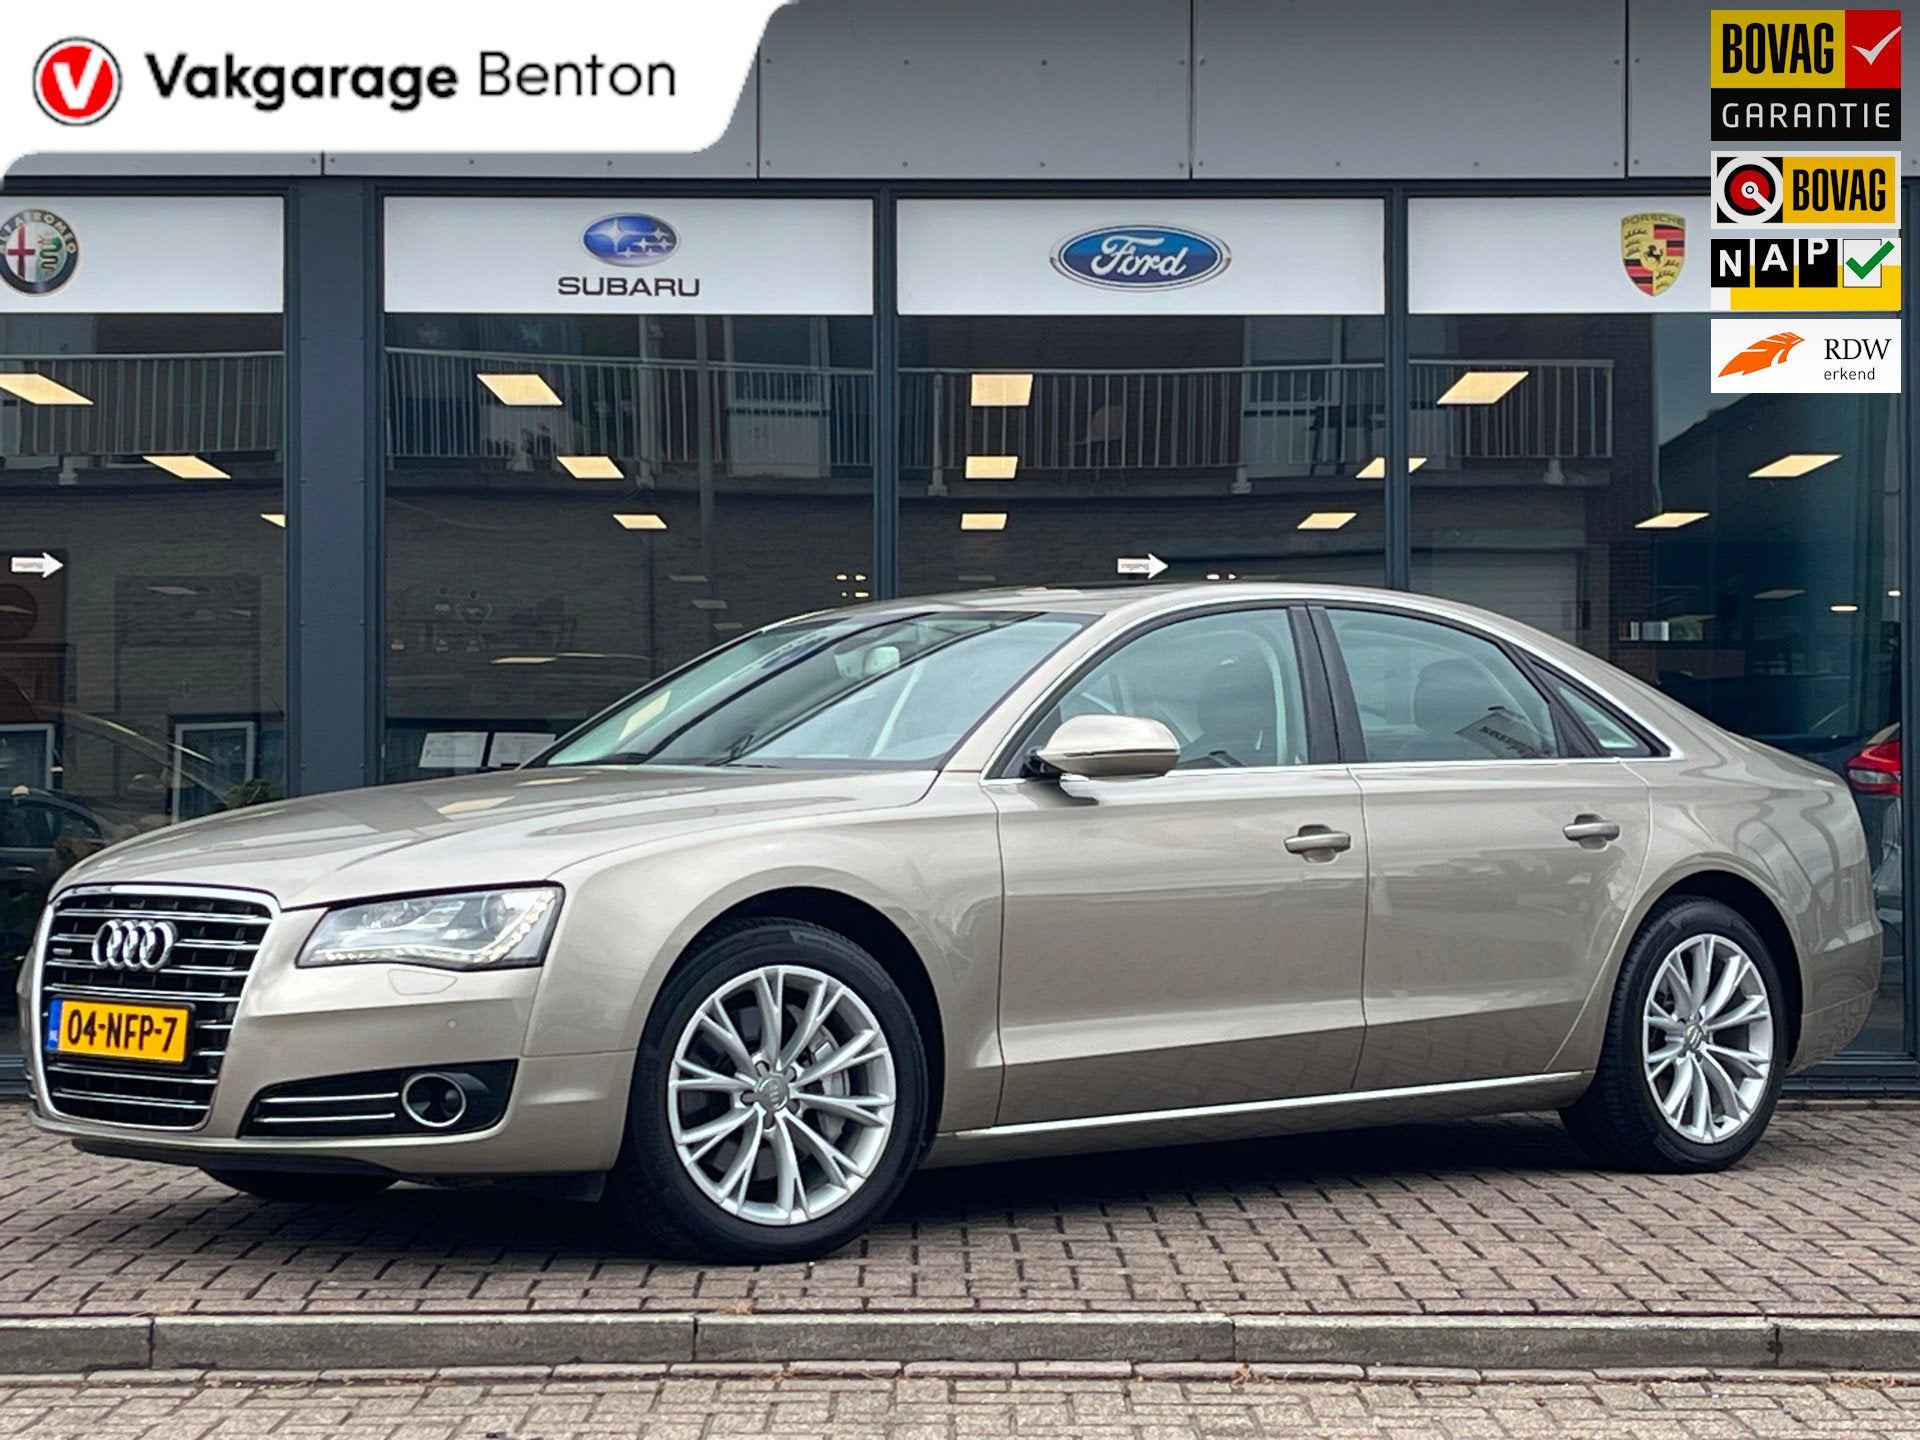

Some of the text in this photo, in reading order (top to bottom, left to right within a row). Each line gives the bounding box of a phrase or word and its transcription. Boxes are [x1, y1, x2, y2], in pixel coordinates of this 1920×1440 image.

[1090, 234, 1190, 277] Ford
[557, 276, 701, 298] SUBARU
[66, 1008, 179, 1054] 04-NFP-7
